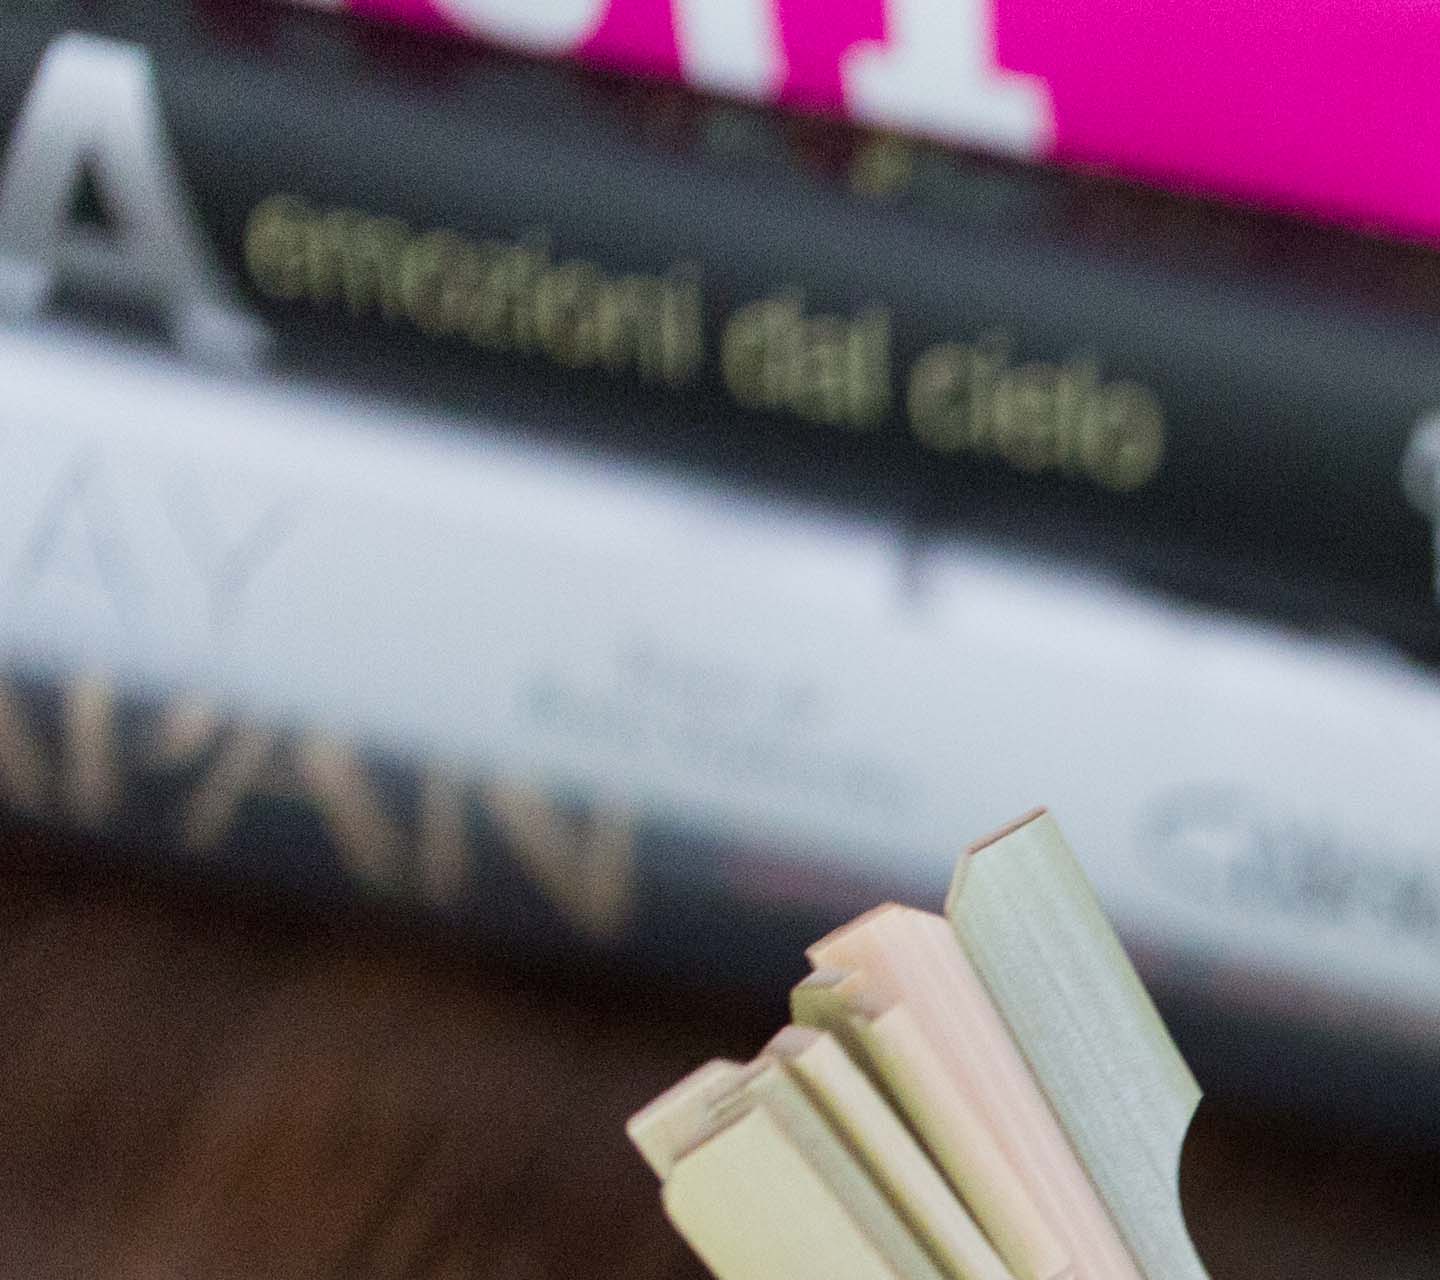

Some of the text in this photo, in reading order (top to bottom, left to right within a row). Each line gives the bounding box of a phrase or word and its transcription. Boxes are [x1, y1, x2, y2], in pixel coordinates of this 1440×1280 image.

[245, 196, 1164, 490] emozioni dal cielo
